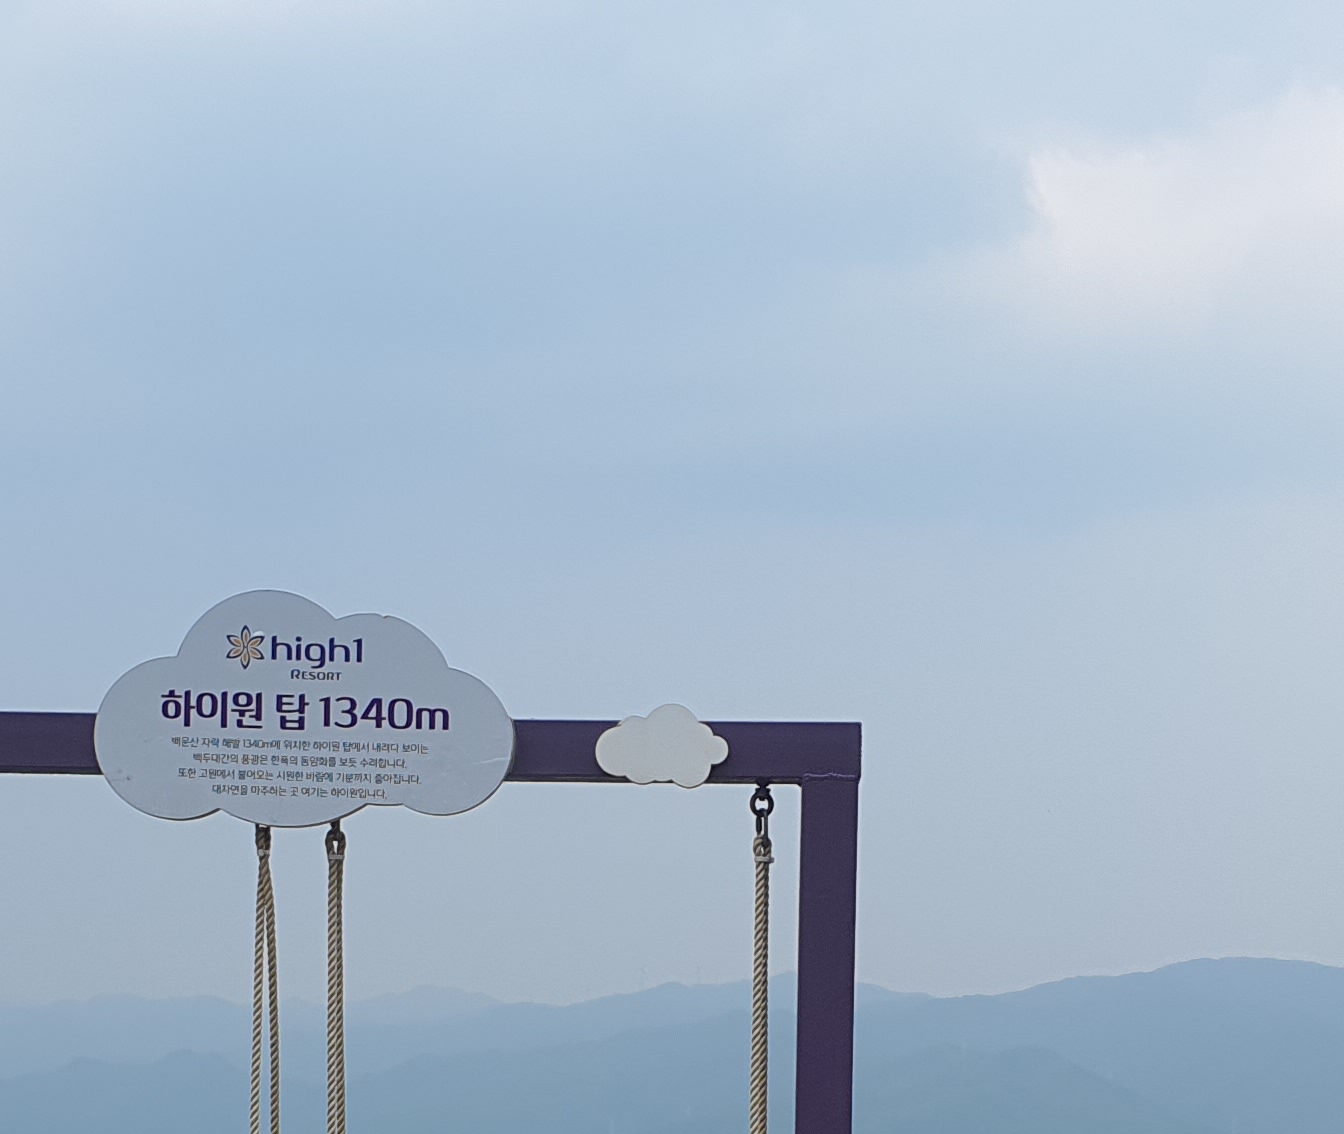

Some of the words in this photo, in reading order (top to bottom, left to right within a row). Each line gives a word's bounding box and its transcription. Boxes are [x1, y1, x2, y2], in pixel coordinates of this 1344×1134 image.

[271, 635, 363, 669] high1
[290, 669, 342, 681] RESORT
[161, 690, 263, 729] 하이원
[276, 693, 309, 730] 탑
[319, 696, 450, 731] 1340m
[201, 737, 219, 748] 자락
[283, 739, 310, 751] 위치한
[313, 740, 340, 752] 하이원
[343, 741, 369, 753] 탑에서
[372, 742, 399, 753] 내려다
[402, 743, 429, 755] 보이는
[193, 752, 239, 764] 백두대간의
[338, 757, 357, 768] 보듯
[360, 757, 407, 769] 수려합니다.
[178, 767, 196, 779] 또한
[198, 768, 235, 780] 고원에서
[238, 769, 273, 781] 불어오는
[276, 770, 303, 782] 시원한
[306, 771, 333, 783] 바람에
[336, 772, 372, 783] 기분까지
[375, 773, 422, 785] 좋아집니다.
[212, 784, 248, 796] 대자연을
[251, 785, 287, 797] 마주하는
[301, 787, 329, 798] 여기는
[331, 787, 387, 800] 하이원입니다.
